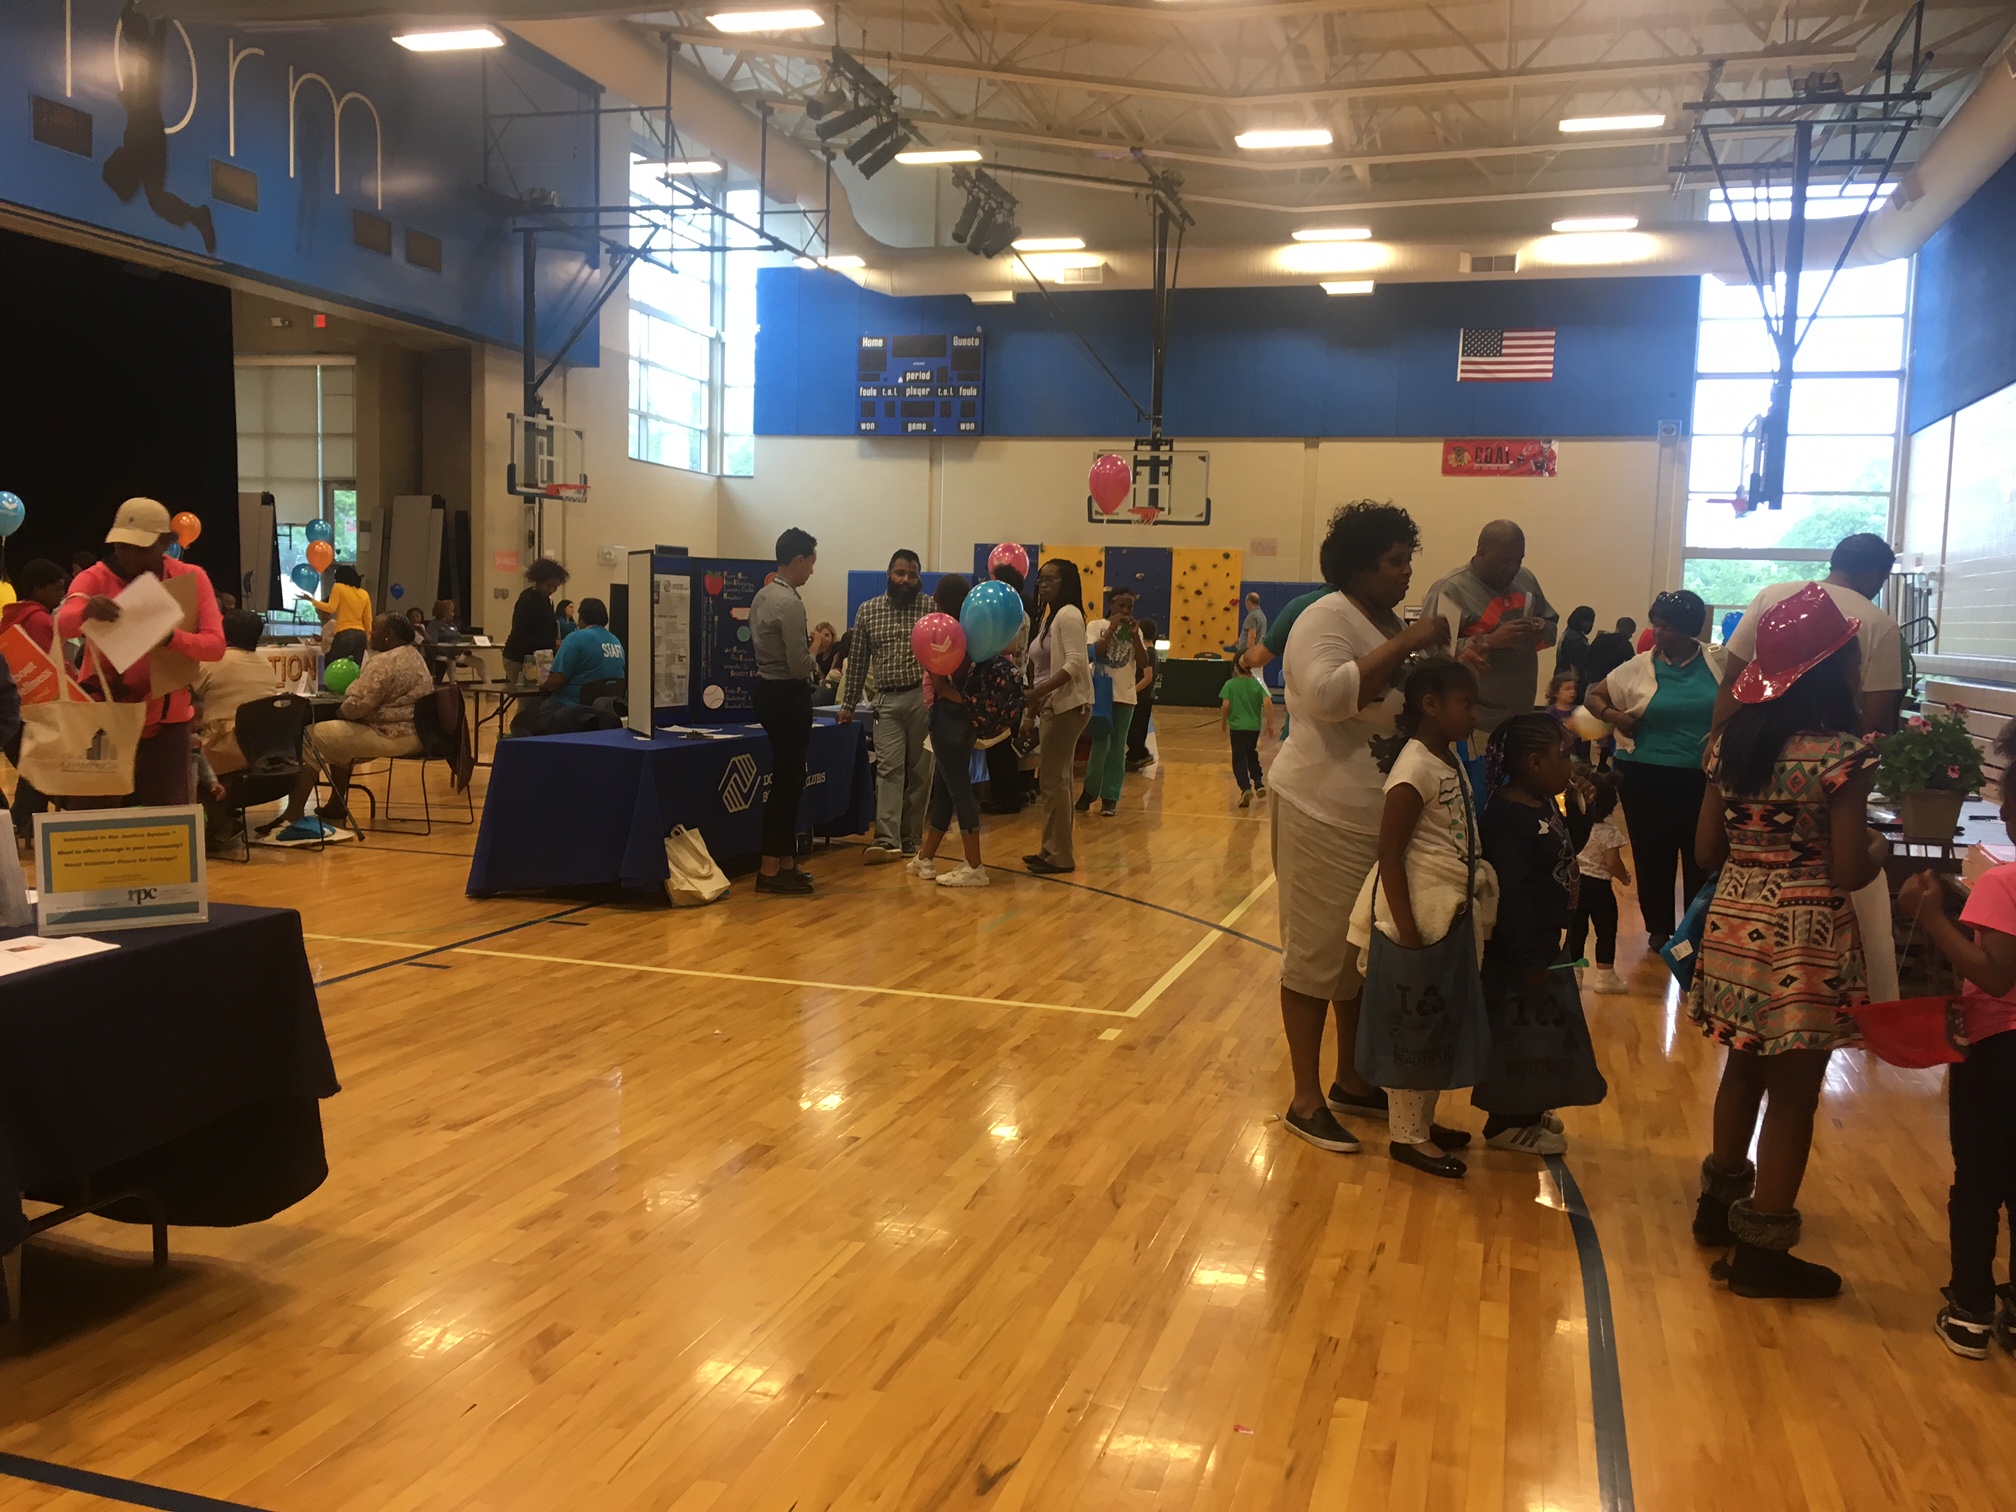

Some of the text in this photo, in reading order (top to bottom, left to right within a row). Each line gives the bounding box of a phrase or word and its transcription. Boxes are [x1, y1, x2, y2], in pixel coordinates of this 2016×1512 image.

[862, 337, 883, 347] Home
[953, 336, 980, 346] Guests
[905, 370, 931, 382] period
[859, 387, 877, 396] fouls
[905, 386, 931, 397] player
[959, 386, 978, 396] fouls
[860, 422, 875, 430] won
[960, 422, 975, 430] won
[127, 887, 157, 905] rpc
[1396, 984, 1412, 1016] I
